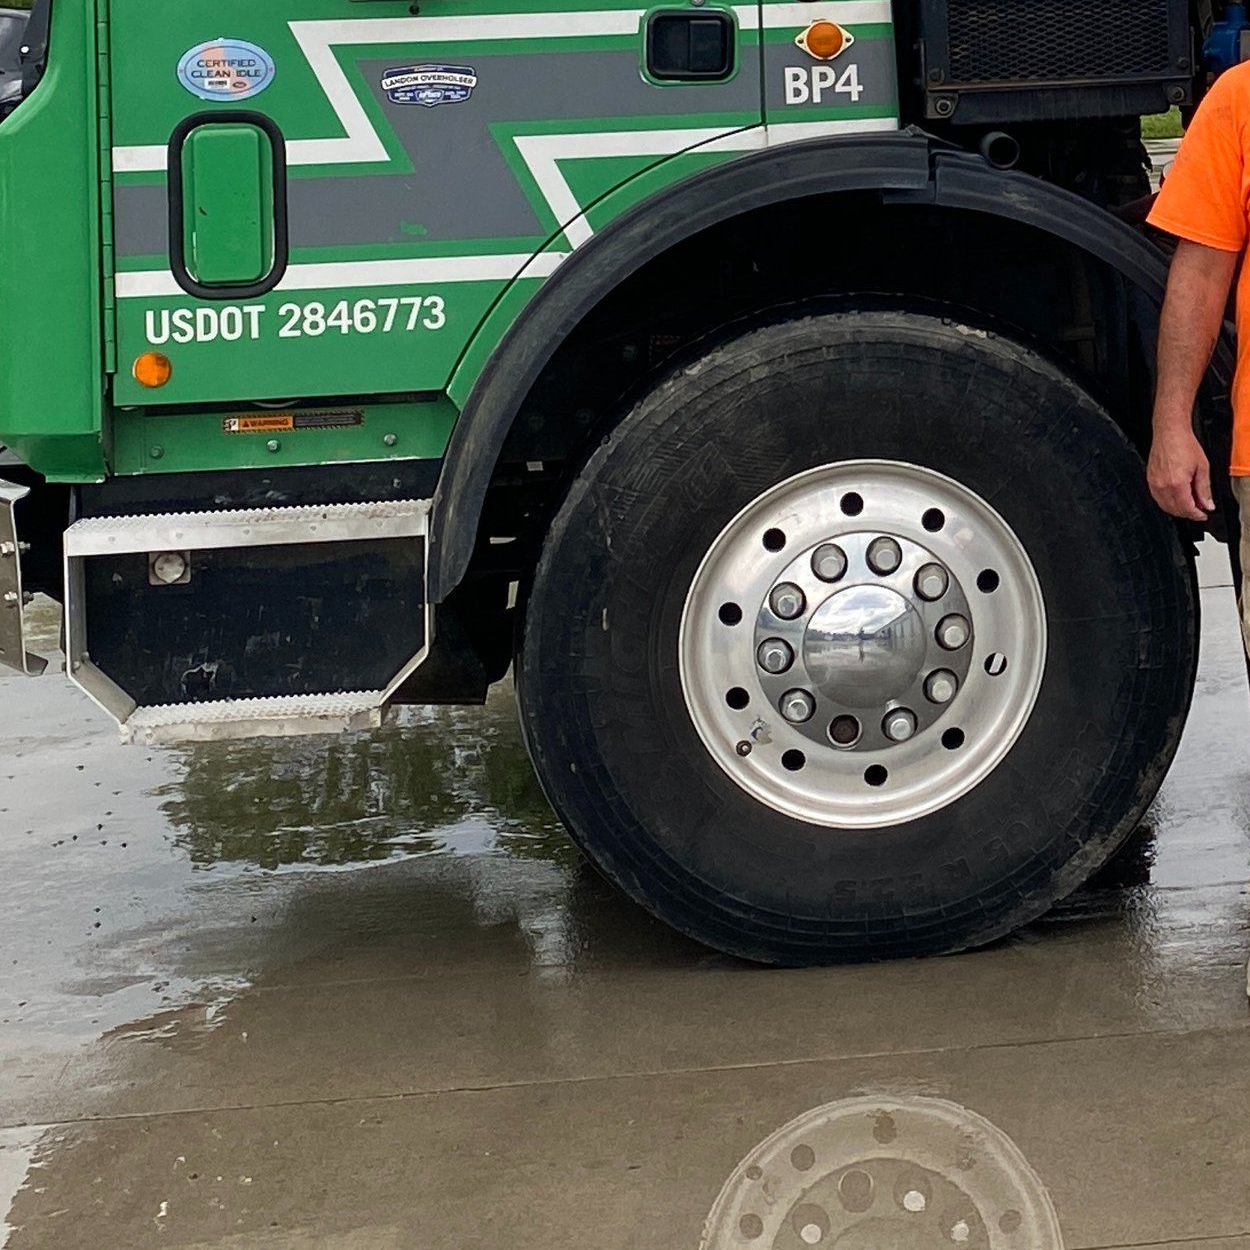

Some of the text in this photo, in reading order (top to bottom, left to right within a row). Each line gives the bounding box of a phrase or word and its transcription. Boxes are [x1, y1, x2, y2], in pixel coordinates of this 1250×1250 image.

[196, 59, 257, 68] CERTIFIED
[191, 70, 262, 79] CLEAN IDLE
[384, 75, 419, 88] LANDON
[420, 74, 474, 85] OVERHOLSER
[784, 63, 864, 105] BP4
[145, 295, 446, 345] USDOT 2846773
[250, 419, 289, 427] WARNING
